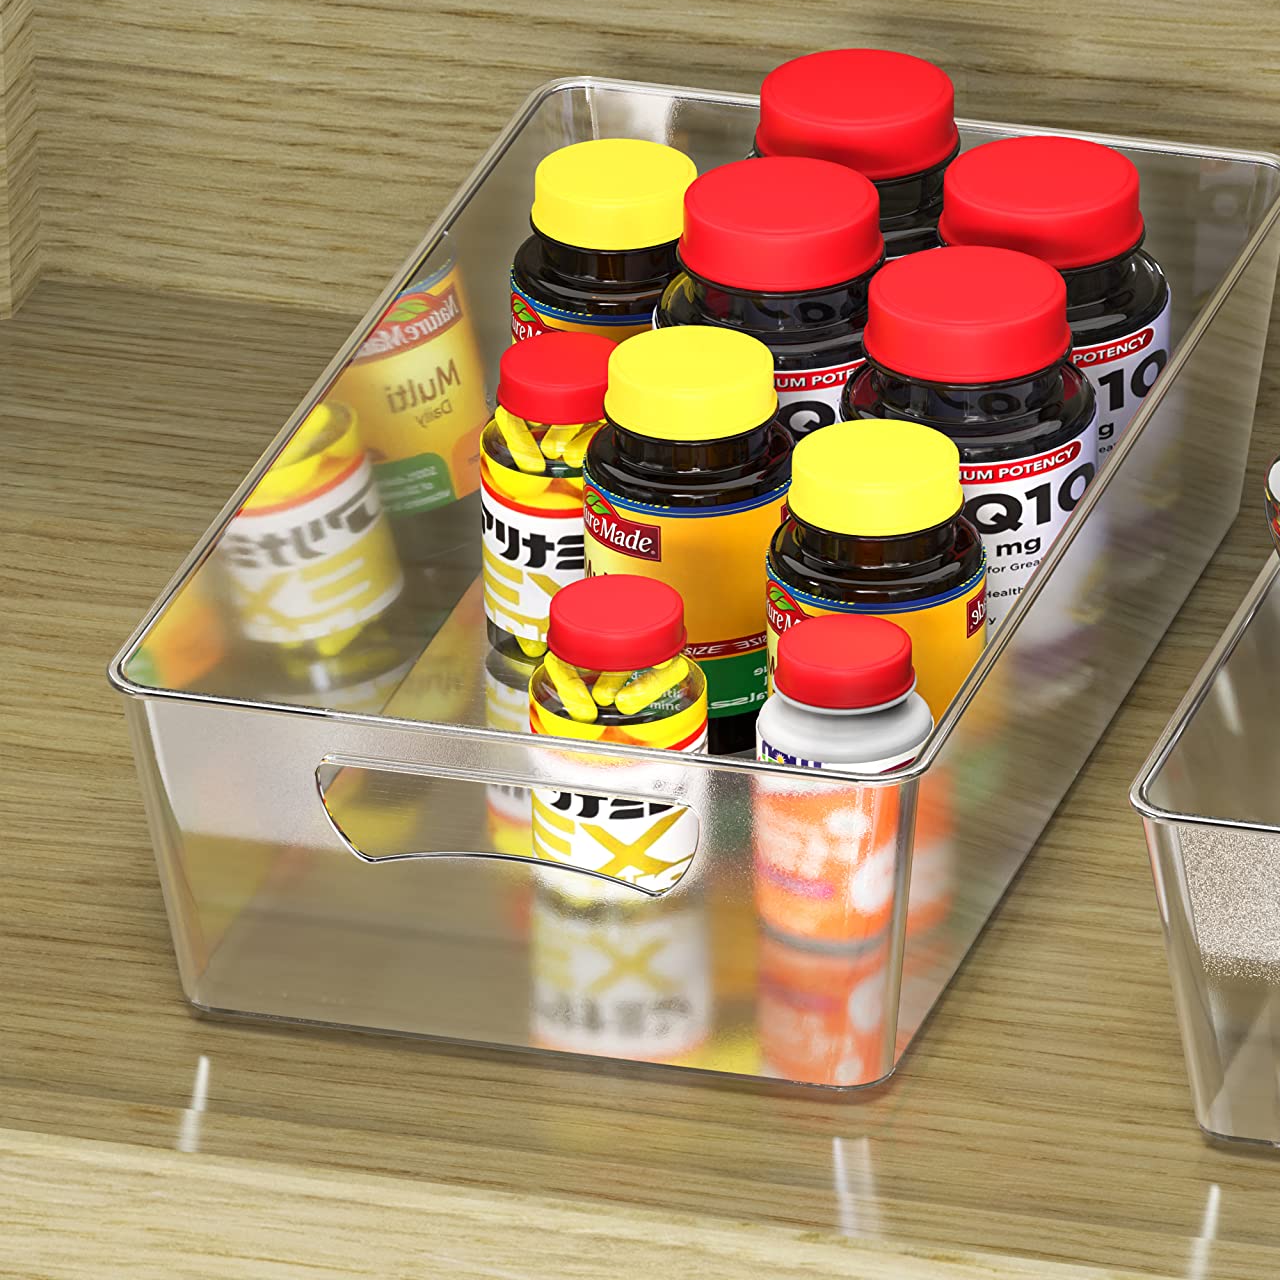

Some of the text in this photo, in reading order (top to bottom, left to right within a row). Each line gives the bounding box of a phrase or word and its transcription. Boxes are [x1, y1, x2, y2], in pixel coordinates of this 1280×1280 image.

[1073, 333, 1147, 364] POTENCY
[998, 446, 1076, 479] POTENCY
[600, 516, 653, 553] Made
[996, 536, 1042, 557] mg
[986, 564, 1007, 574] for
